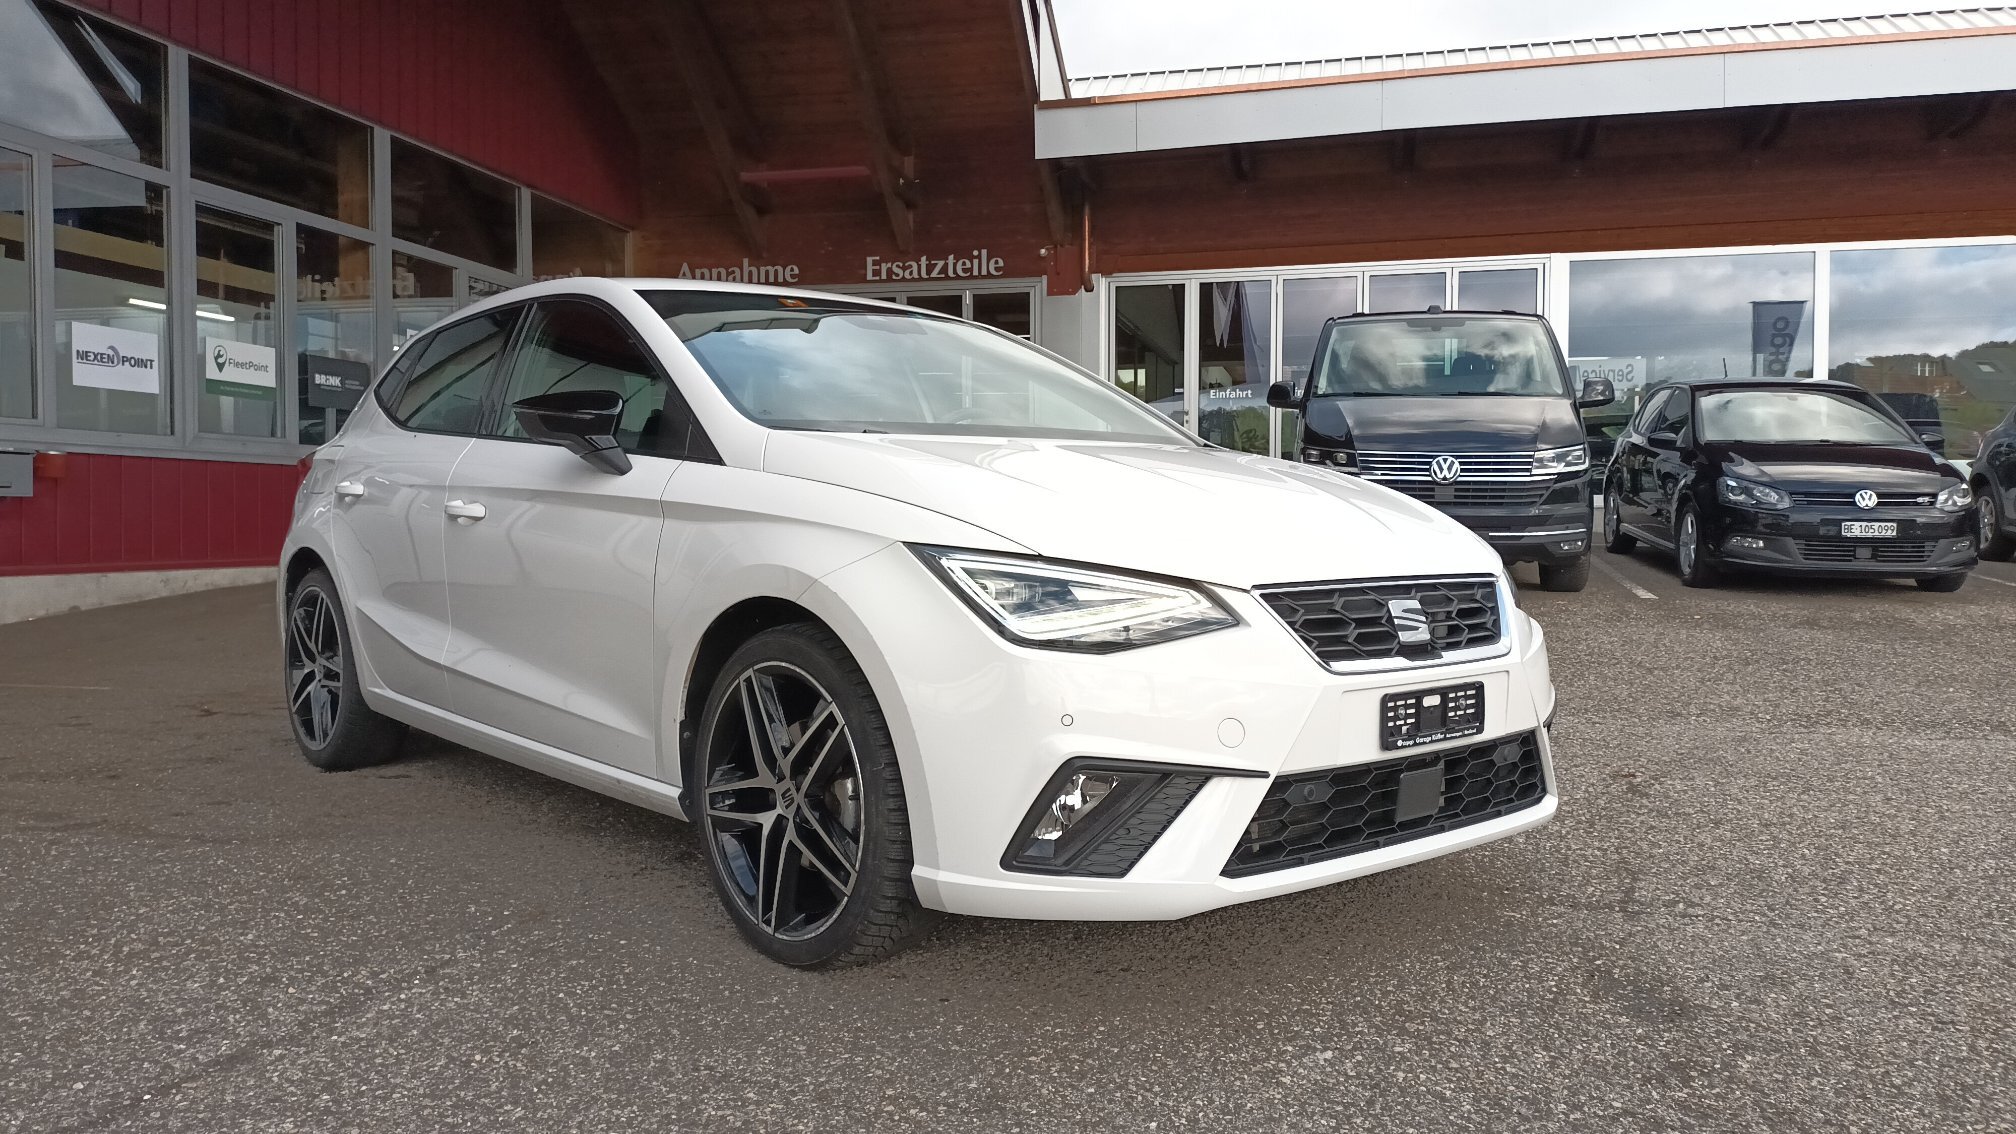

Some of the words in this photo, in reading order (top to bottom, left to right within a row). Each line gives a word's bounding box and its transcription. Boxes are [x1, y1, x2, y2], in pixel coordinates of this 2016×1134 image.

[677, 257, 800, 284] Annahme
[866, 248, 1005, 280] Ersatzteile
[76, 349, 115, 365] NEXEN
[121, 355, 155, 370] POINT
[228, 357, 270, 373] FleetPoint
[1209, 389, 1253, 399] Einfahrt
